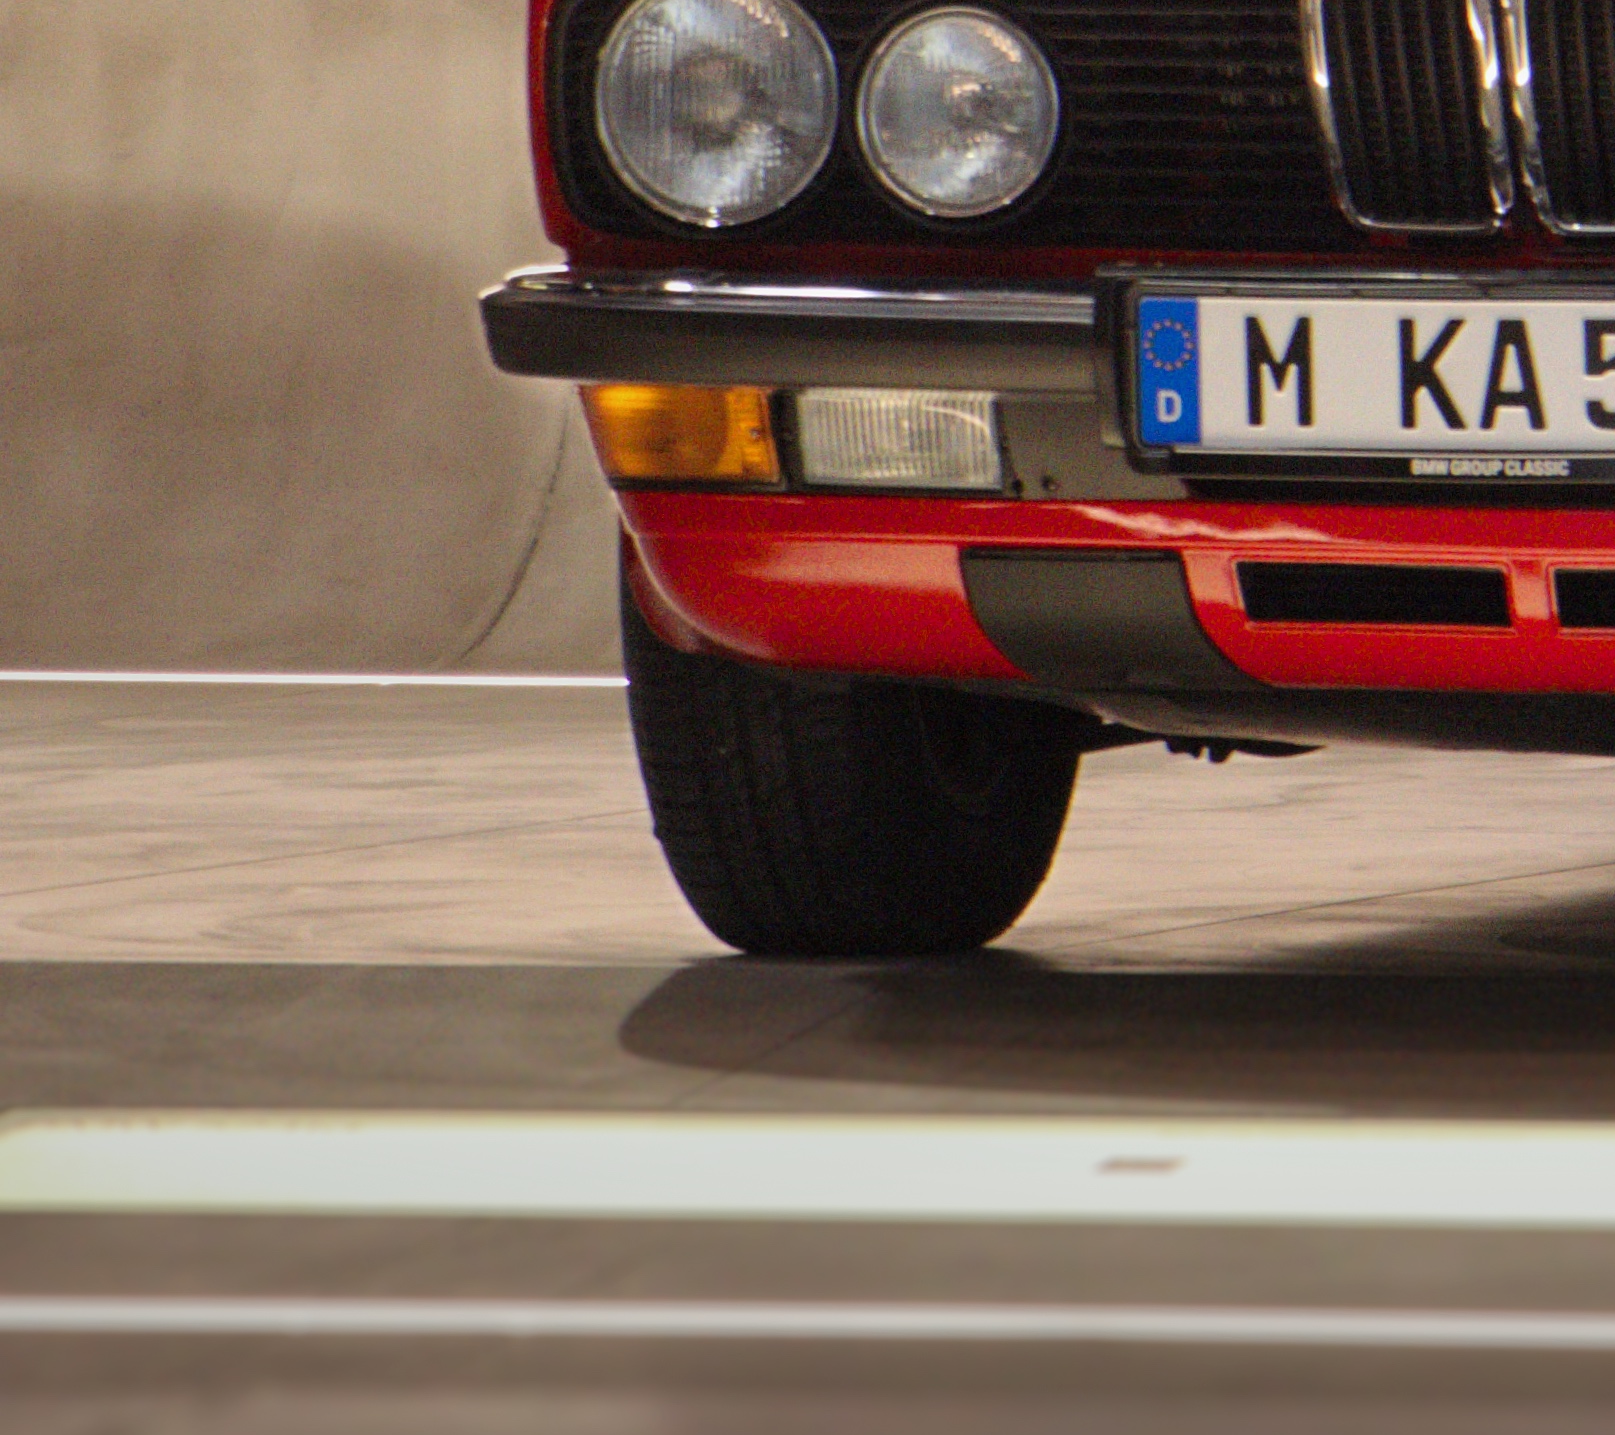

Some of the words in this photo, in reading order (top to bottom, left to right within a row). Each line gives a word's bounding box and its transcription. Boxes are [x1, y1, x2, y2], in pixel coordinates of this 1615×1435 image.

[1245, 316, 1313, 427] M
[1398, 318, 1547, 430] KA
[1157, 390, 1183, 424] D
[1411, 459, 1449, 476] BMW
[1450, 459, 1502, 476] GROUP
[1503, 460, 1570, 476] CLASSIC
